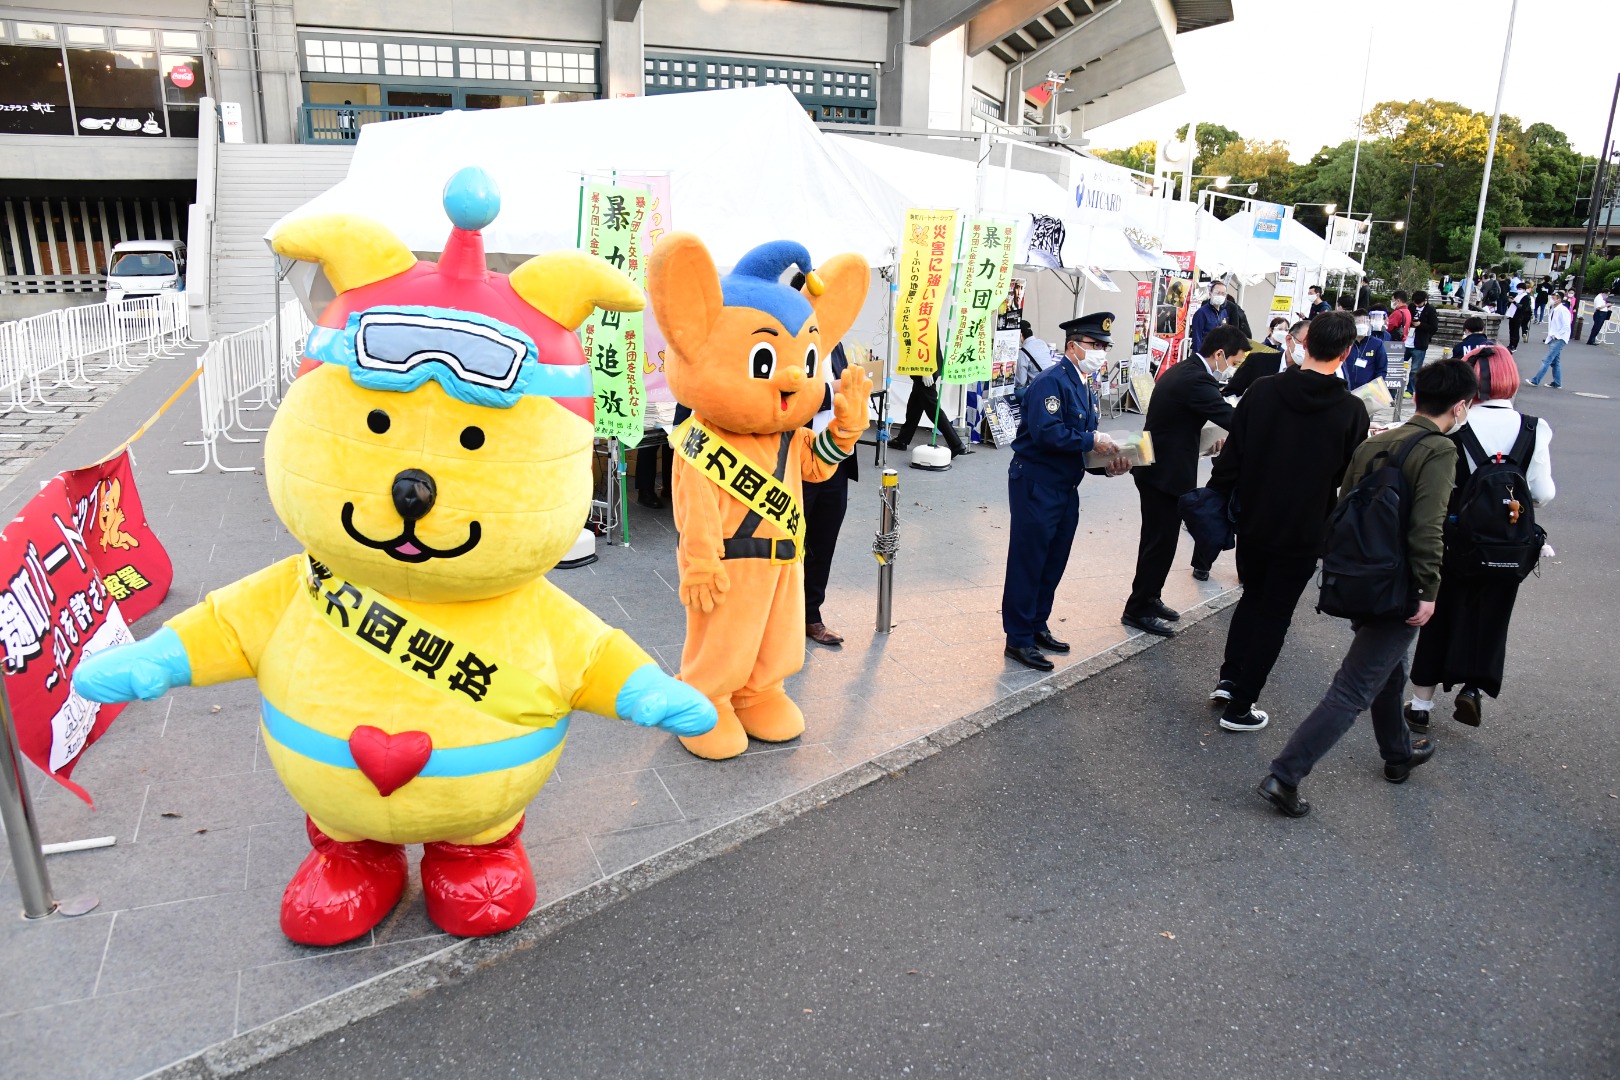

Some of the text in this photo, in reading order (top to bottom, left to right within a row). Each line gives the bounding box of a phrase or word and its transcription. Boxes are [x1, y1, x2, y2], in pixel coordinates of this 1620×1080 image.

[917, 224, 947, 363] 災害に強い街づくり
[1386, 380, 1402, 388] VISA
[681, 424, 801, 536] 暴力団追放
